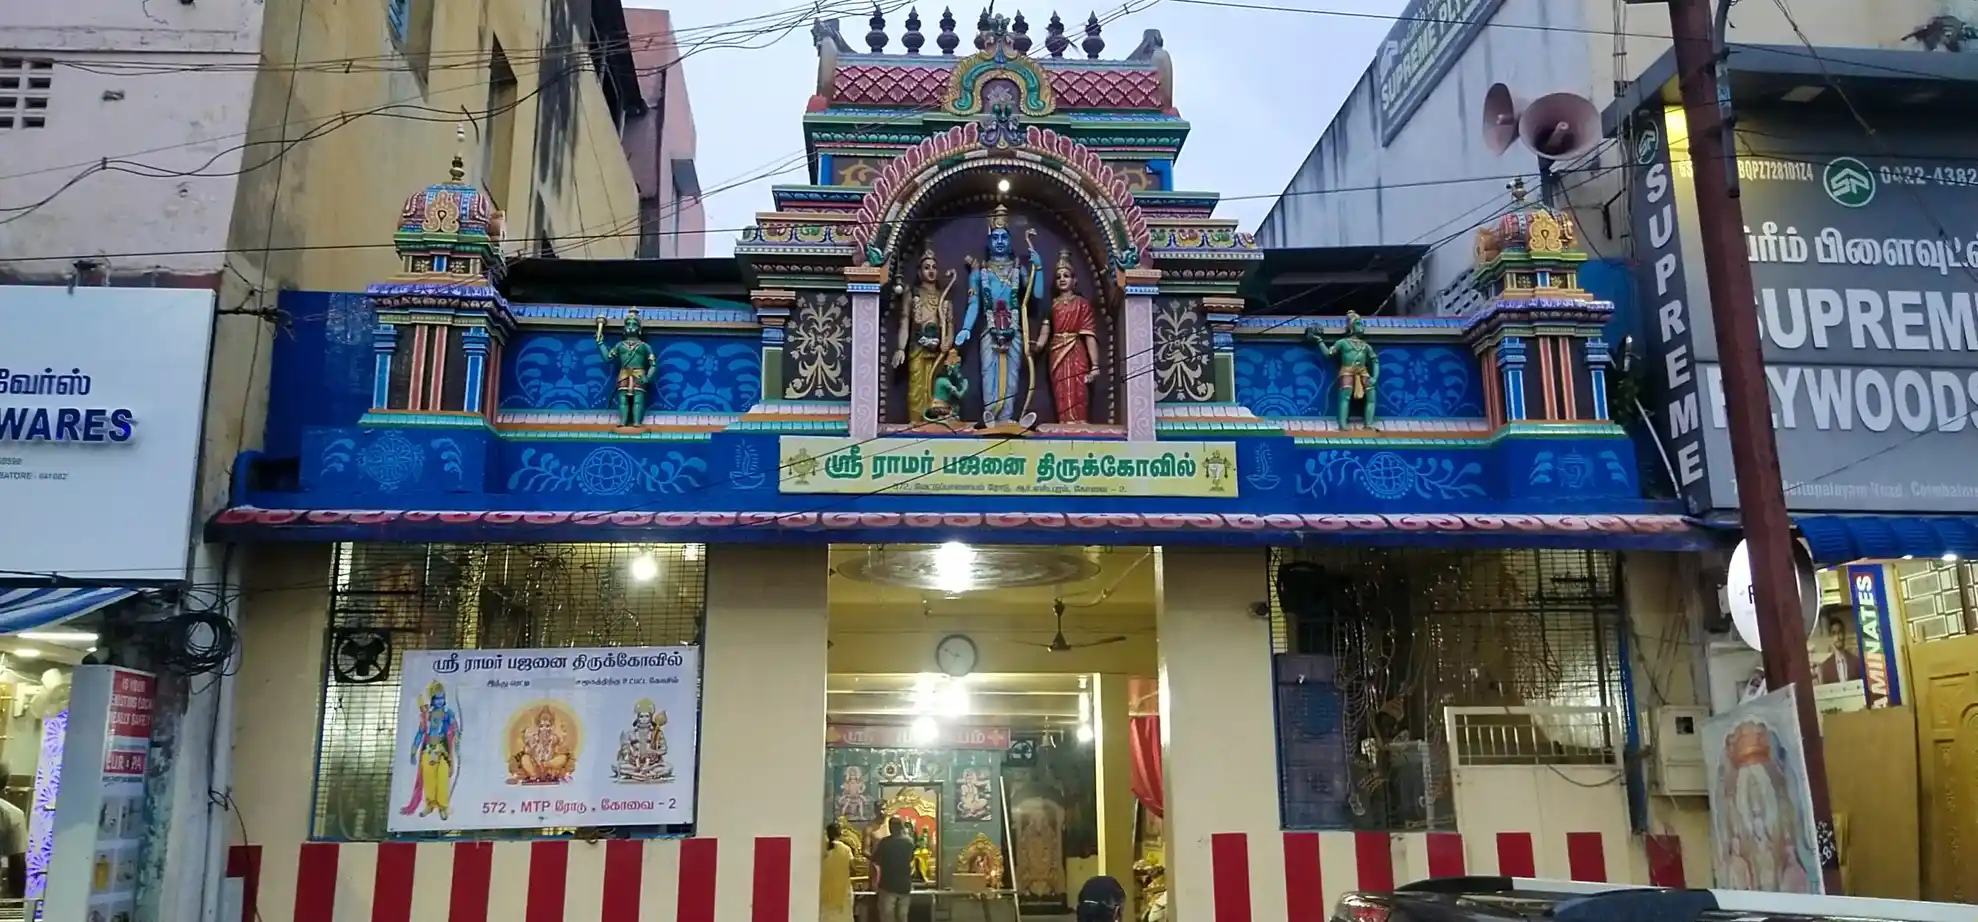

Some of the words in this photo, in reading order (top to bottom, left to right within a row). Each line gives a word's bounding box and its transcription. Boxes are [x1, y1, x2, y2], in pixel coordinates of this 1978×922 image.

[1382, 18, 1437, 111] SUPREME
[1645, 163, 1704, 487] SUPREME
[1754, 289, 1978, 350] UPREM
[0, 407, 133, 442] WARES
[825, 445, 864, 479] ஸ்ரீ
[872, 449, 935, 480] ராமர்
[943, 455, 1027, 476] பஜனை
[1037, 452, 1197, 483] திருக்கோவில்
[432, 652, 460, 674] ஸ்ரீ
[464, 654, 503, 673] ராமர்
[507, 656, 568, 672] பஜனை
[572, 651, 684, 672] திருக்கோவில்
[521, 800, 551, 813] MTP
[554, 800, 587, 814] ரோடு
[601, 799, 655, 811] கோவை
[669, 798, 678, 809] 2
